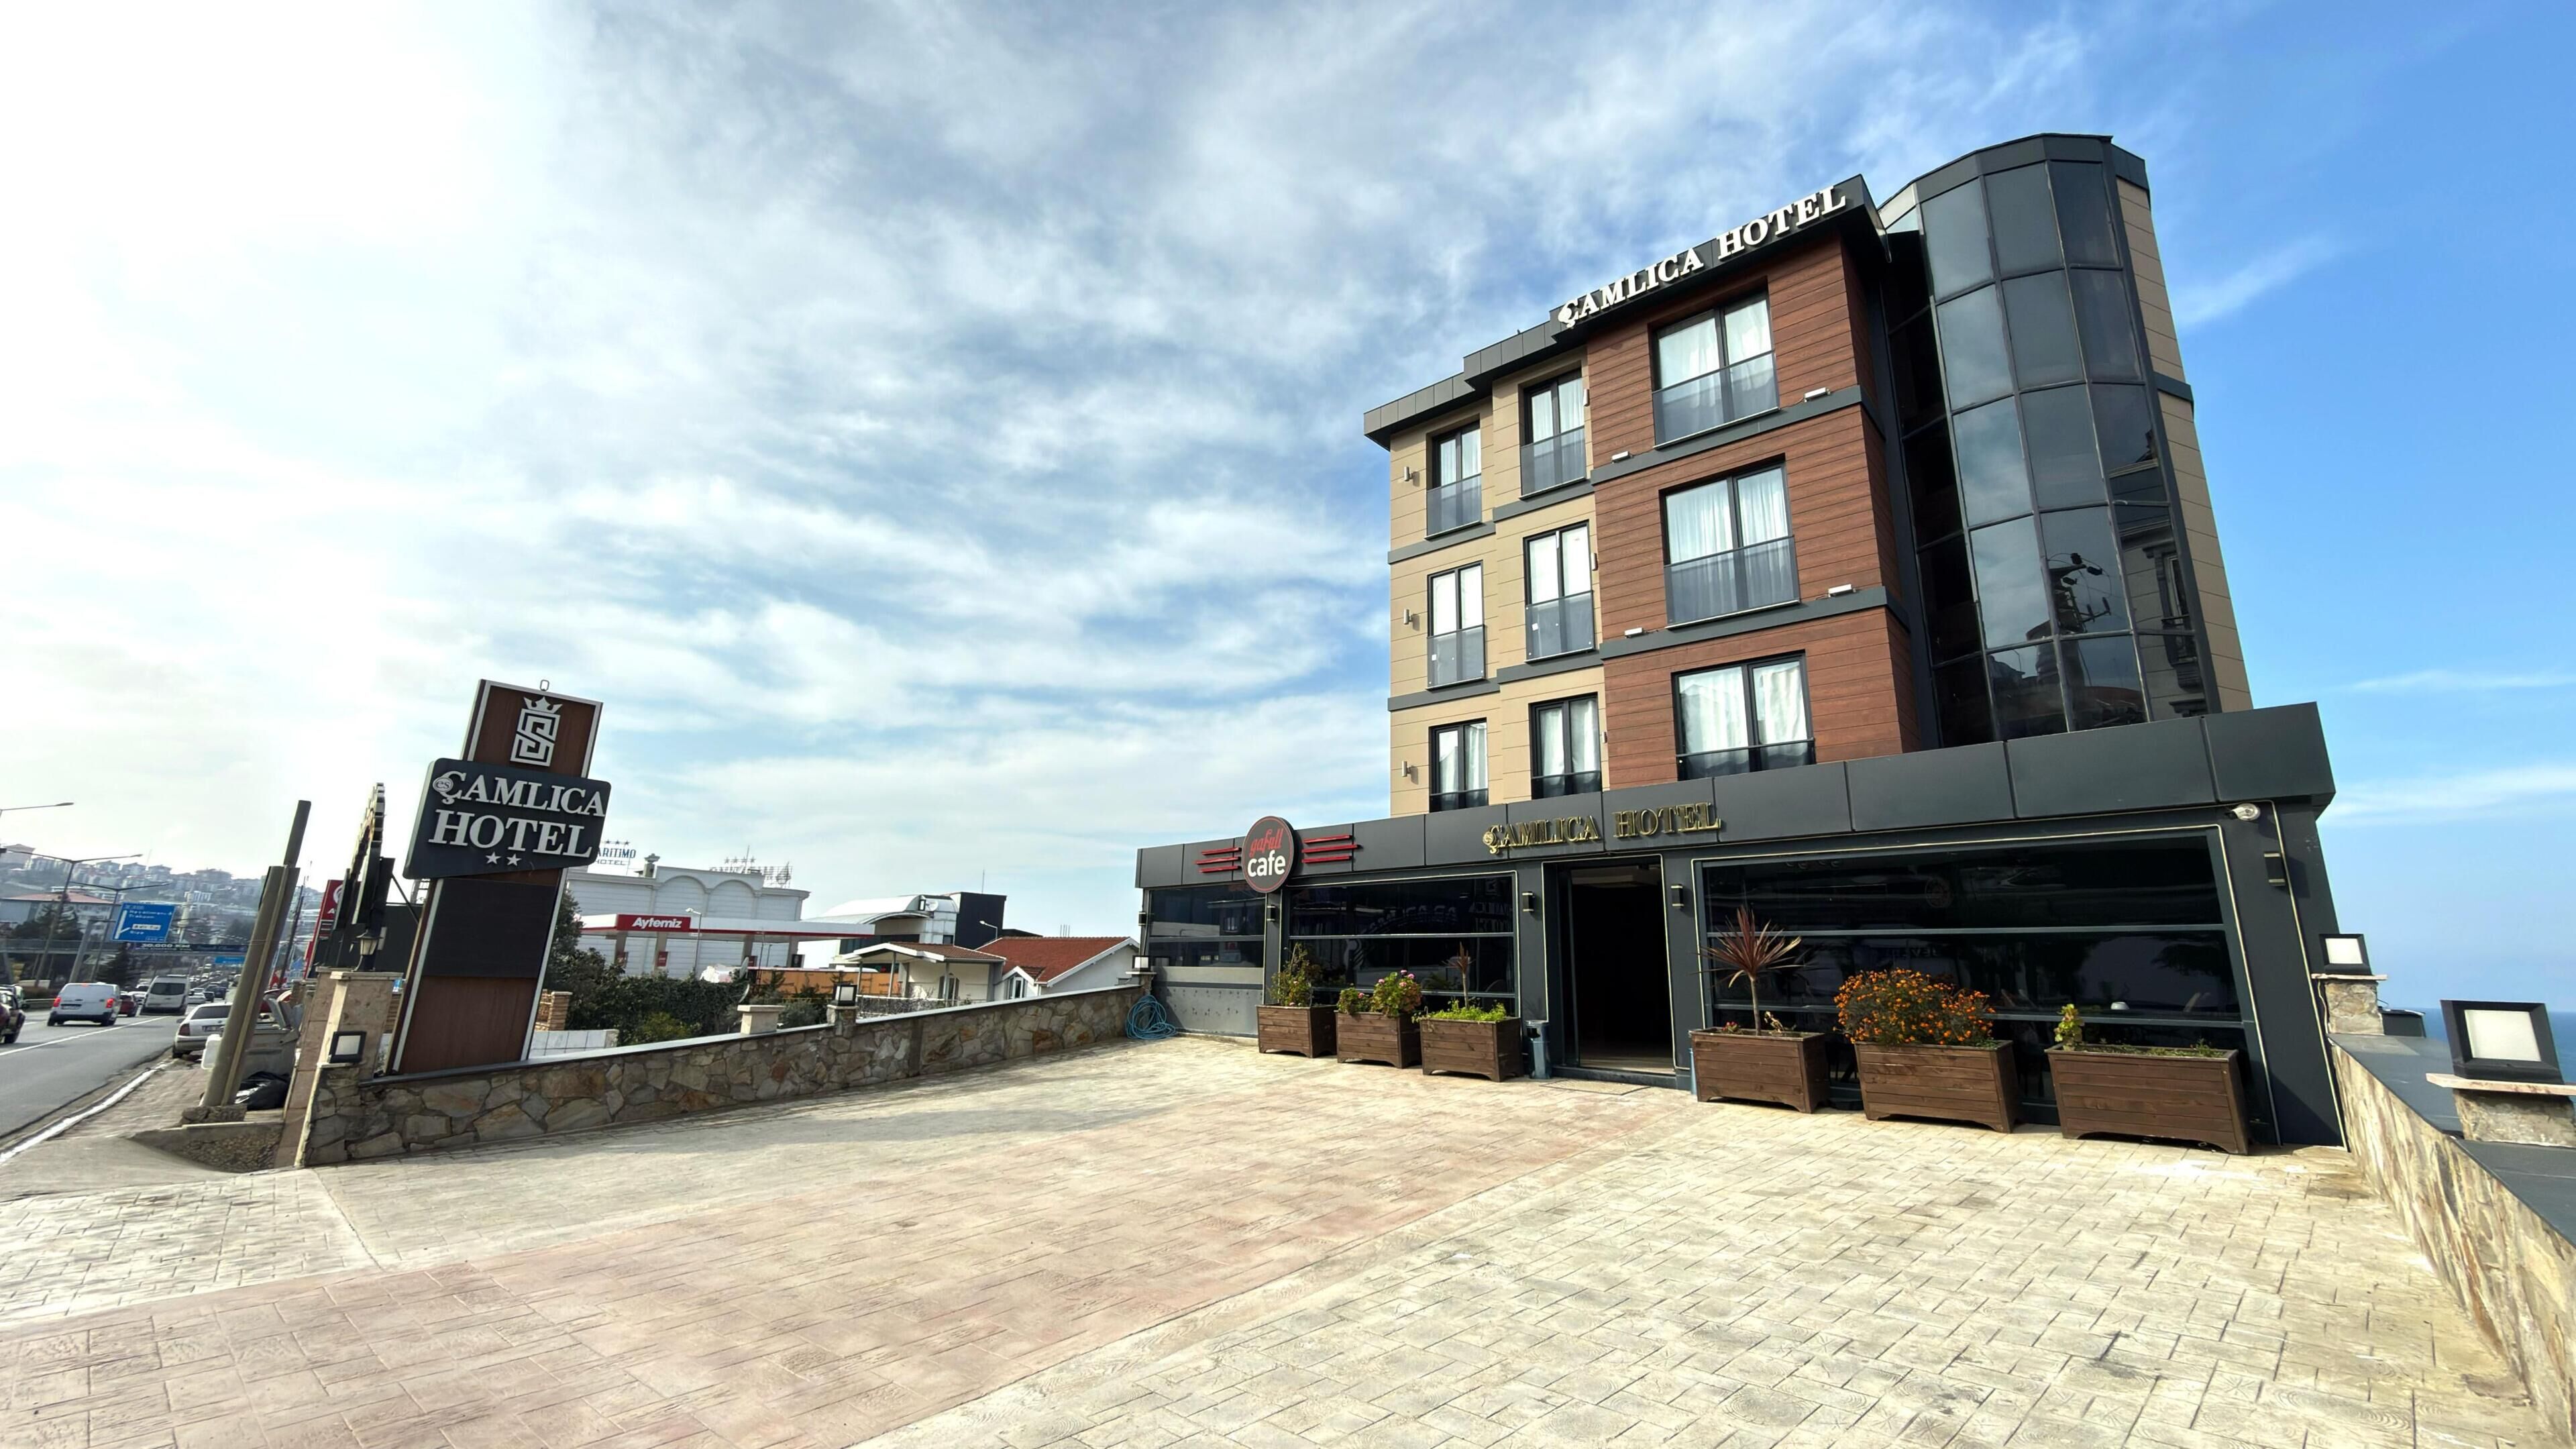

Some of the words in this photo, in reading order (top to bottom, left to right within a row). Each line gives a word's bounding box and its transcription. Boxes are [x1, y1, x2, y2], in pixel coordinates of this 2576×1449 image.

[1558, 248, 1704, 328] ÇAMLICA
[1717, 186, 1846, 260] HOTEL
[432, 771, 606, 817] ÇAMLICA
[428, 809, 593, 858] HOTEL
[1483, 815, 1601, 854] ÇAMLICA
[1612, 802, 1721, 839] HOTEL
[1247, 849, 1286, 877] cafe
[632, 917, 683, 929] Aytemiz
